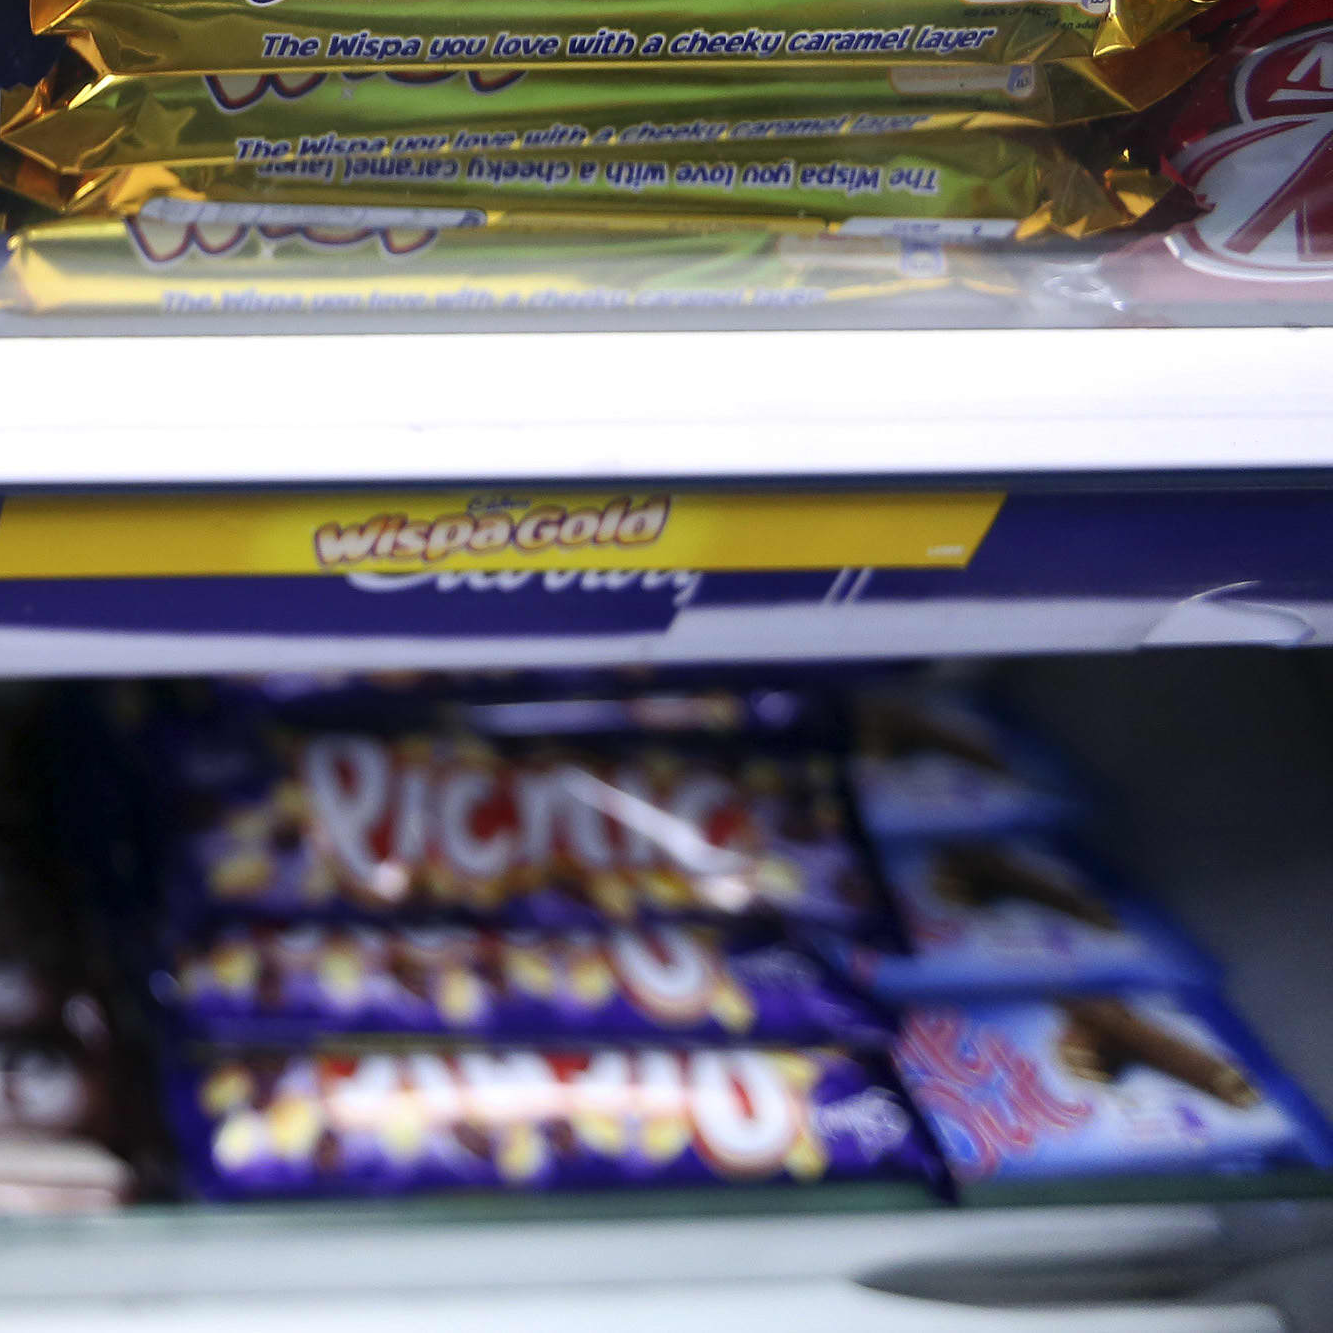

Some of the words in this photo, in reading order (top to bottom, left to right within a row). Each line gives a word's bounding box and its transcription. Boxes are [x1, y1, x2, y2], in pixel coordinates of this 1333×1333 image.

[263, 33, 320, 58] The
[327, 32, 422, 62] Wispa
[429, 37, 484, 62] you
[492, 33, 559, 57] love
[568, 28, 635, 57] with
[641, 32, 664, 54] a
[670, 29, 784, 57] cheeky
[788, 26, 911, 55] caramel
[915, 25, 996, 54] layer
[467, 157, 571, 188] cheeky
[579, 162, 596, 186] a
[606, 162, 667, 192] with
[675, 163, 733, 191] love
[742, 161, 795, 188] you
[800, 163, 882, 196] Wispa
[890, 166, 939, 192] The
